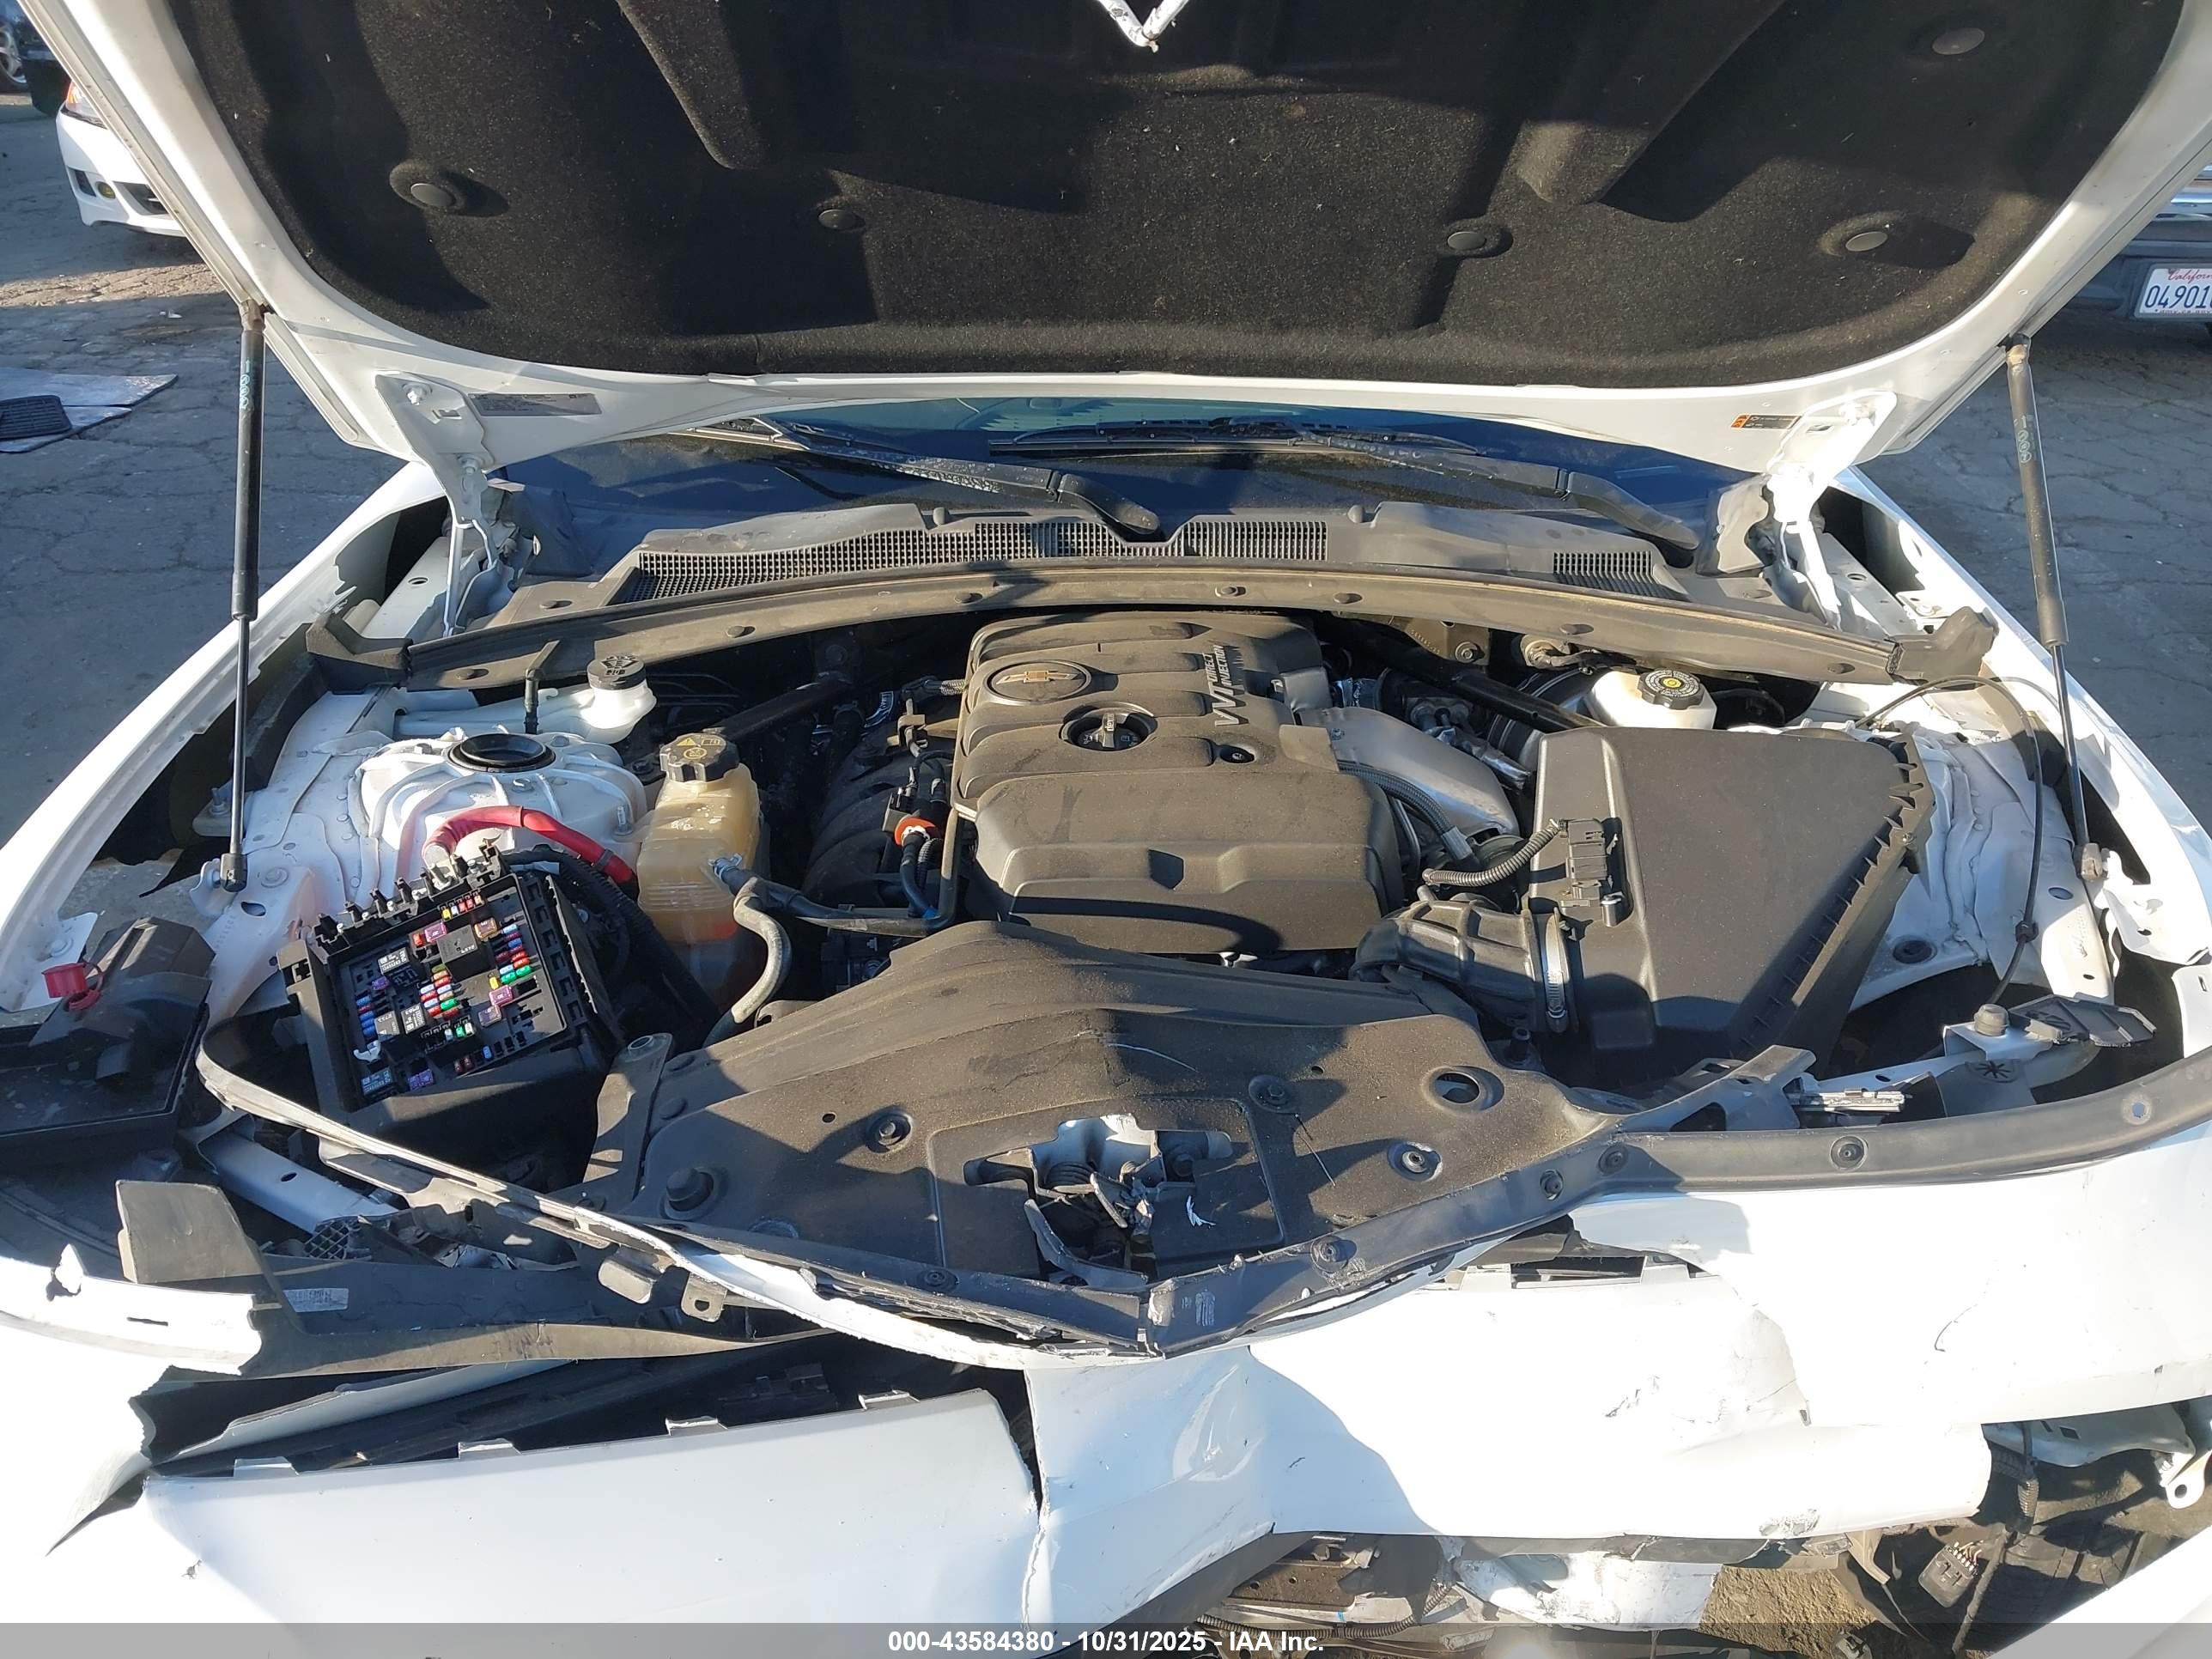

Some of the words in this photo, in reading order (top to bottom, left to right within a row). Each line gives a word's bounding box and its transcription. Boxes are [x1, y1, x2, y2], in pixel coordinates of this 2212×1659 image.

[2145, 285, 2212, 308] 04901
[1202, 653, 1218, 682] DIRECT
[1213, 645, 1232, 686] INJECTION
[1208, 681, 1240, 726] VVT
